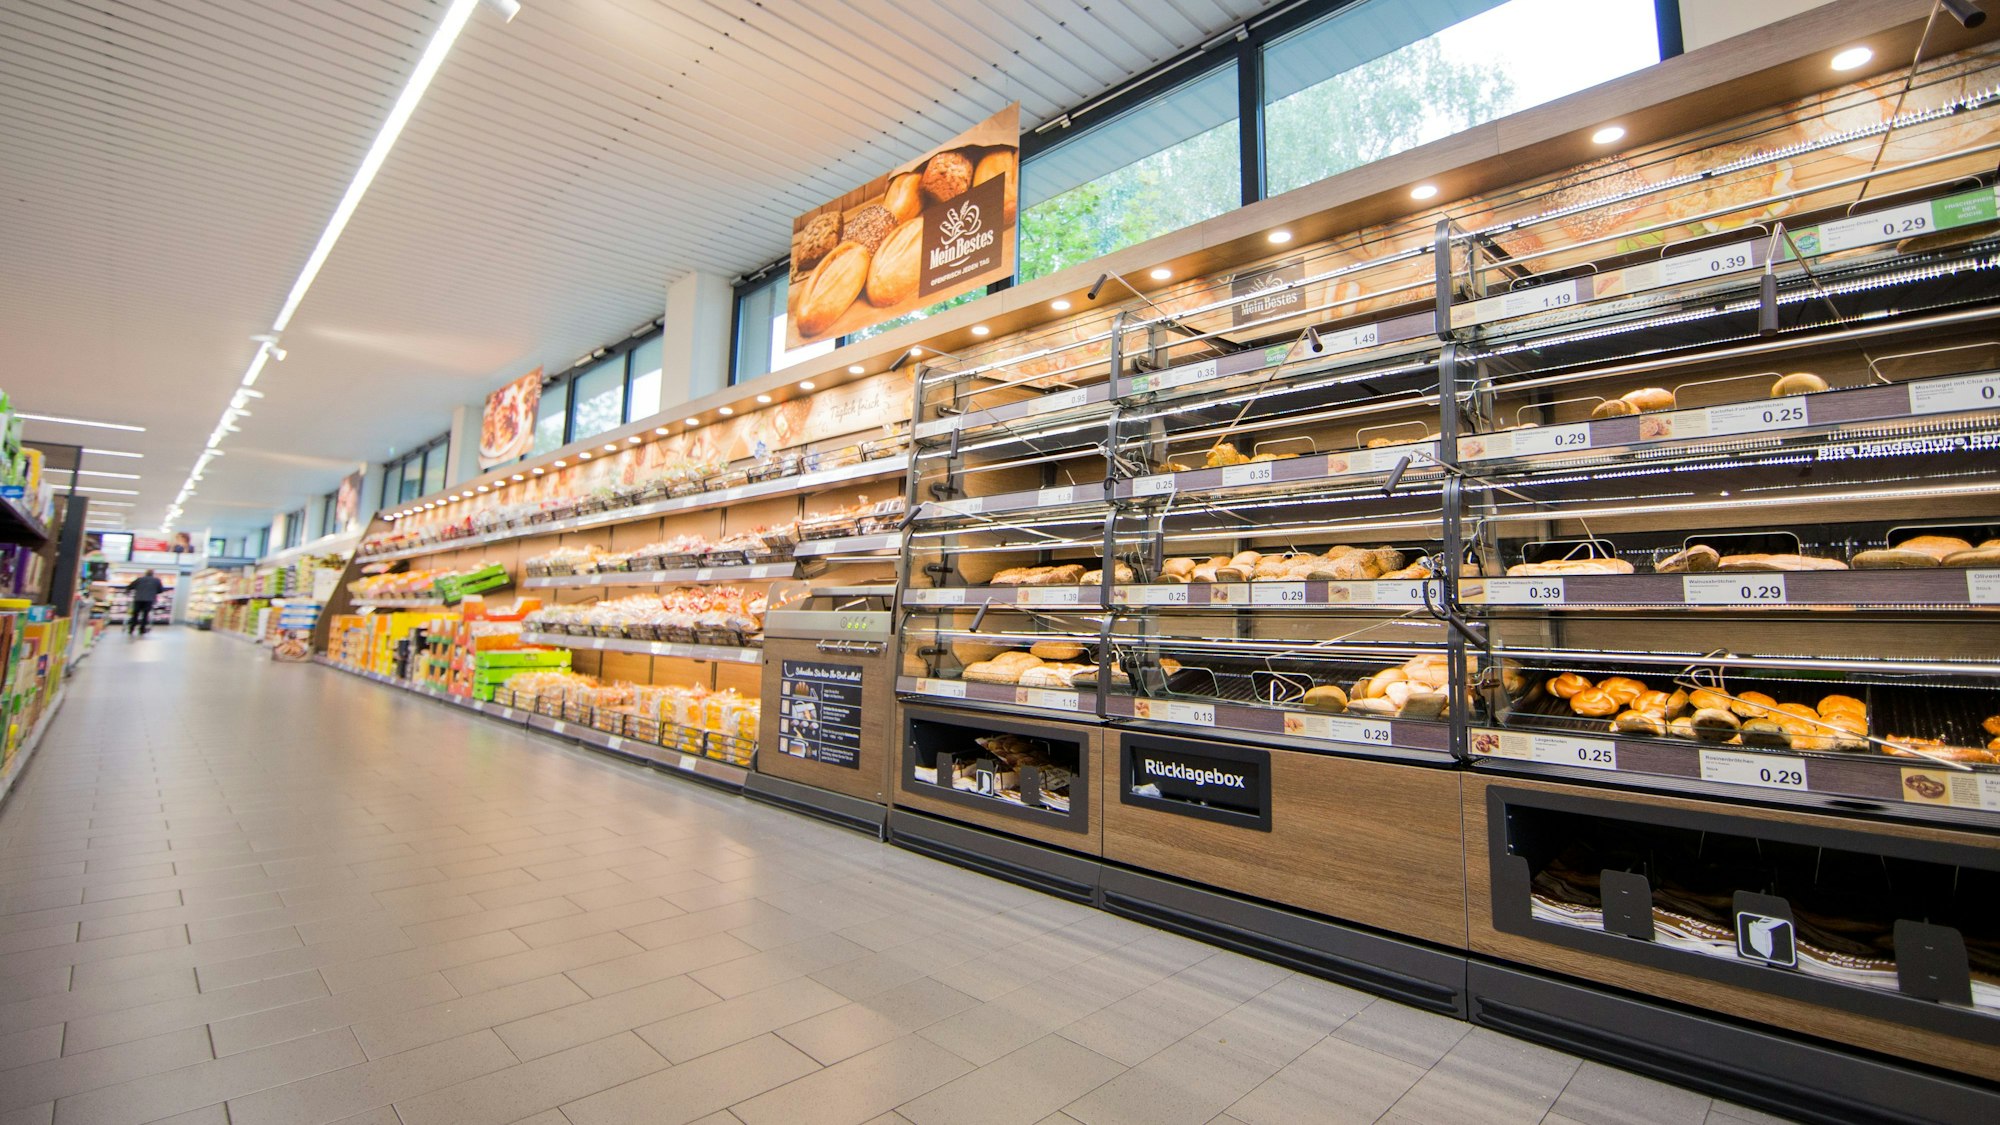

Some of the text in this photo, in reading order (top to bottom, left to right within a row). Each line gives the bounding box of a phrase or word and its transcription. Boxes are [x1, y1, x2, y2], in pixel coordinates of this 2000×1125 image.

[1883, 216, 1926, 236] 0.29
[929, 229, 994, 270] Mein Bestes
[979, 257, 990, 267] TAG
[1711, 255, 1746, 272] 0.39
[1543, 293, 1571, 308] 1.19
[1353, 332, 1375, 346] 1.49
[1197, 367, 1215, 379] 0.35
[1762, 407, 1804, 423] 0.25
[1555, 432, 1586, 446] 0.29
[1859, 436, 1966, 455] Handschuhe
[1250, 469, 1270, 480] 0.35
[1155, 481, 1173, 490] 0.25
[1063, 593, 1077, 601] 1.39
[1168, 592, 1186, 601] 0.25
[1281, 591, 1303, 601] 0.29
[1410, 588, 1437, 599] 0.9
[1529, 587, 1560, 599] 0.39
[1741, 586, 1781, 599] 0.29
[1063, 698, 1077, 708] 1.15
[1193, 711, 1213, 722] 0.13
[1363, 728, 1389, 741] 0.29
[1577, 748, 1612, 763] 0.25
[1144, 758, 1246, 789] Rücklagebox
[1760, 768, 1803, 785] 0.29
